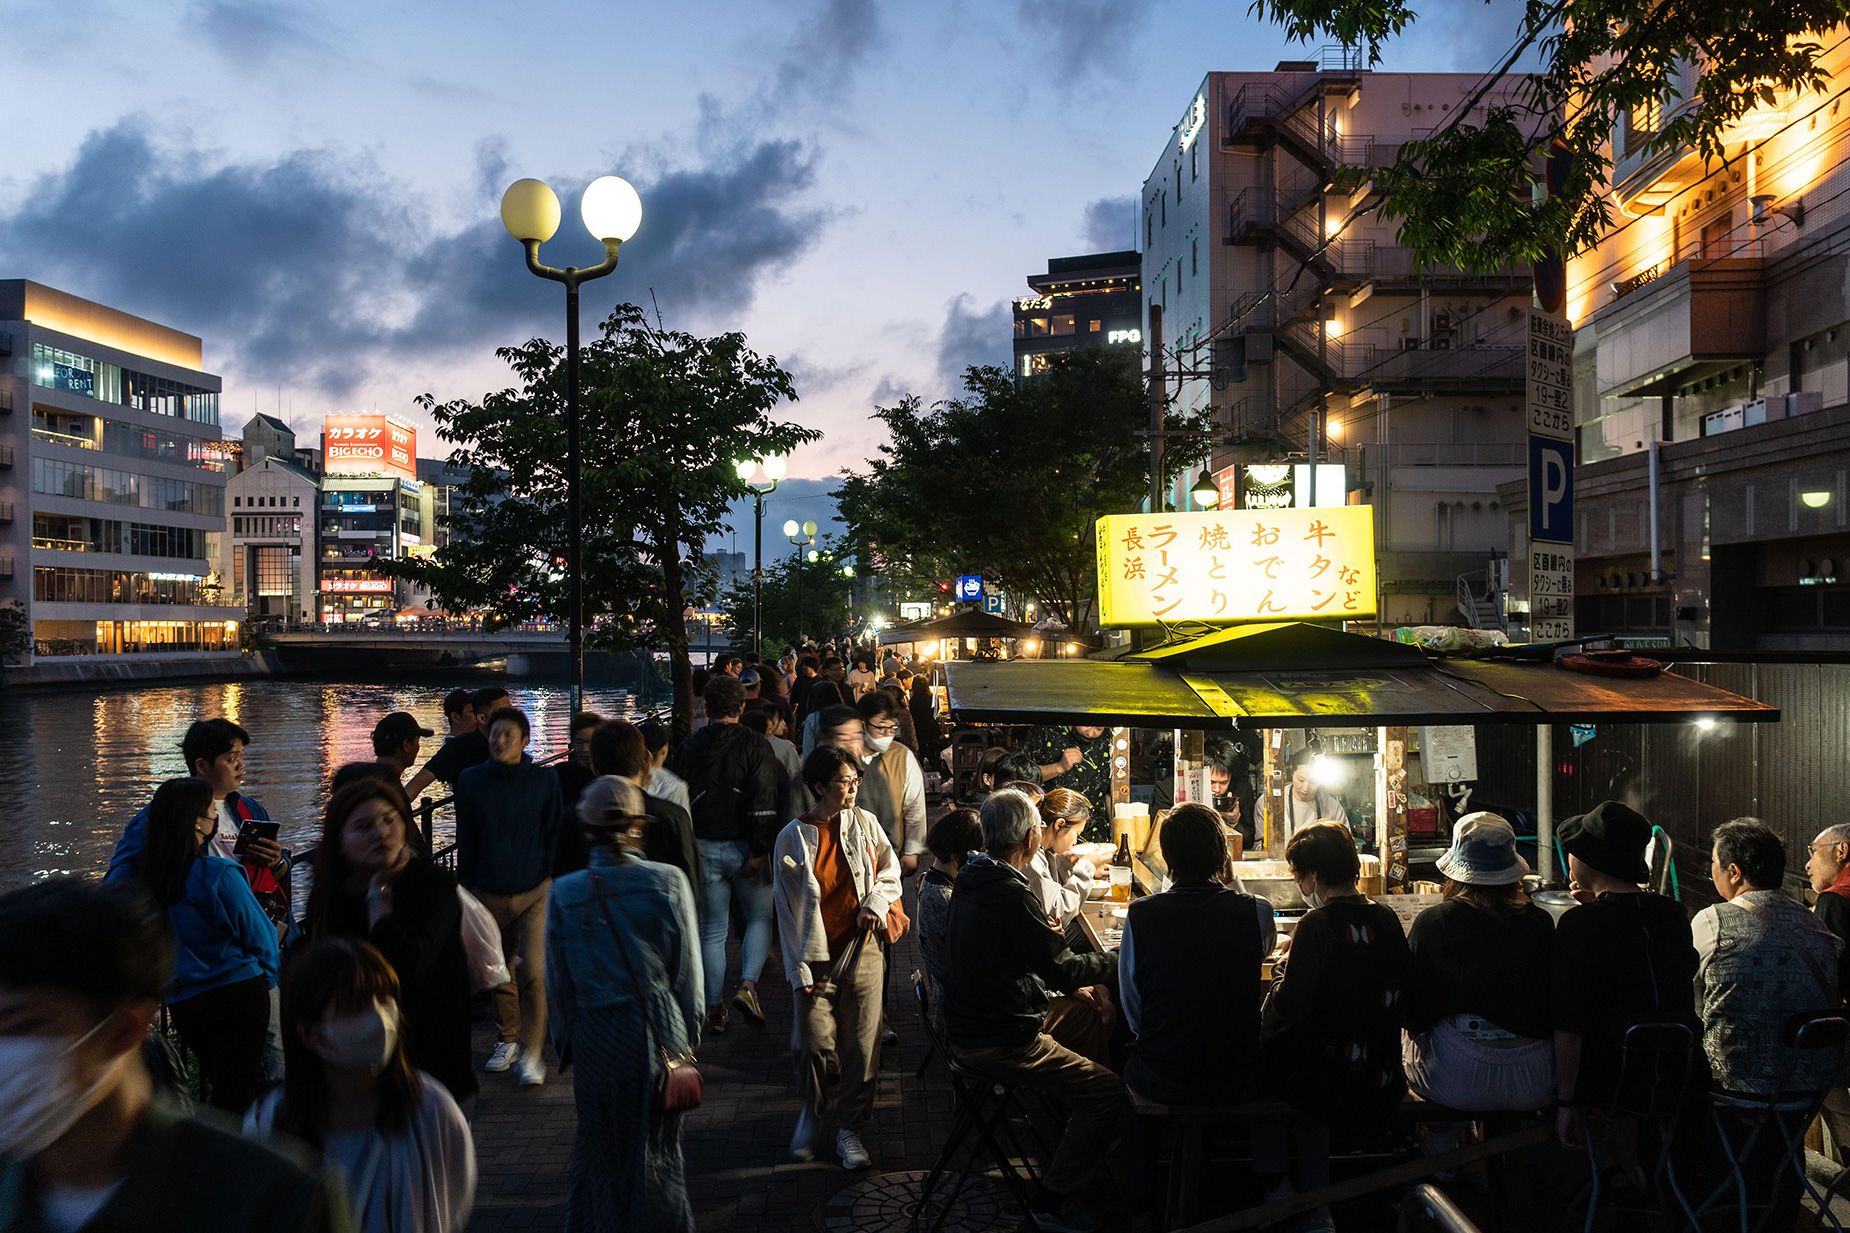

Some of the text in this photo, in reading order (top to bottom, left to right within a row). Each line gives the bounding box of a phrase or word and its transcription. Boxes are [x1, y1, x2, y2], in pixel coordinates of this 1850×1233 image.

[1019, 295, 1053, 311] なだ万
[1108, 328, 1141, 344] FPG
[55, 367, 75, 379] FOR
[68, 378, 93, 390] RENT
[1533, 409, 1570, 431] ここから
[328, 427, 382, 439] カラオケ
[1541, 447, 1567, 530] P
[1121, 526, 1146, 580] 長浜
[1148, 523, 1183, 617] ラーメン
[1199, 522, 1231, 615] 焼とり
[1251, 522, 1287, 614] おでん
[1303, 519, 1361, 612] 牛タン など
[988, 596, 999, 611] P
[1536, 621, 1570, 639] ここから
